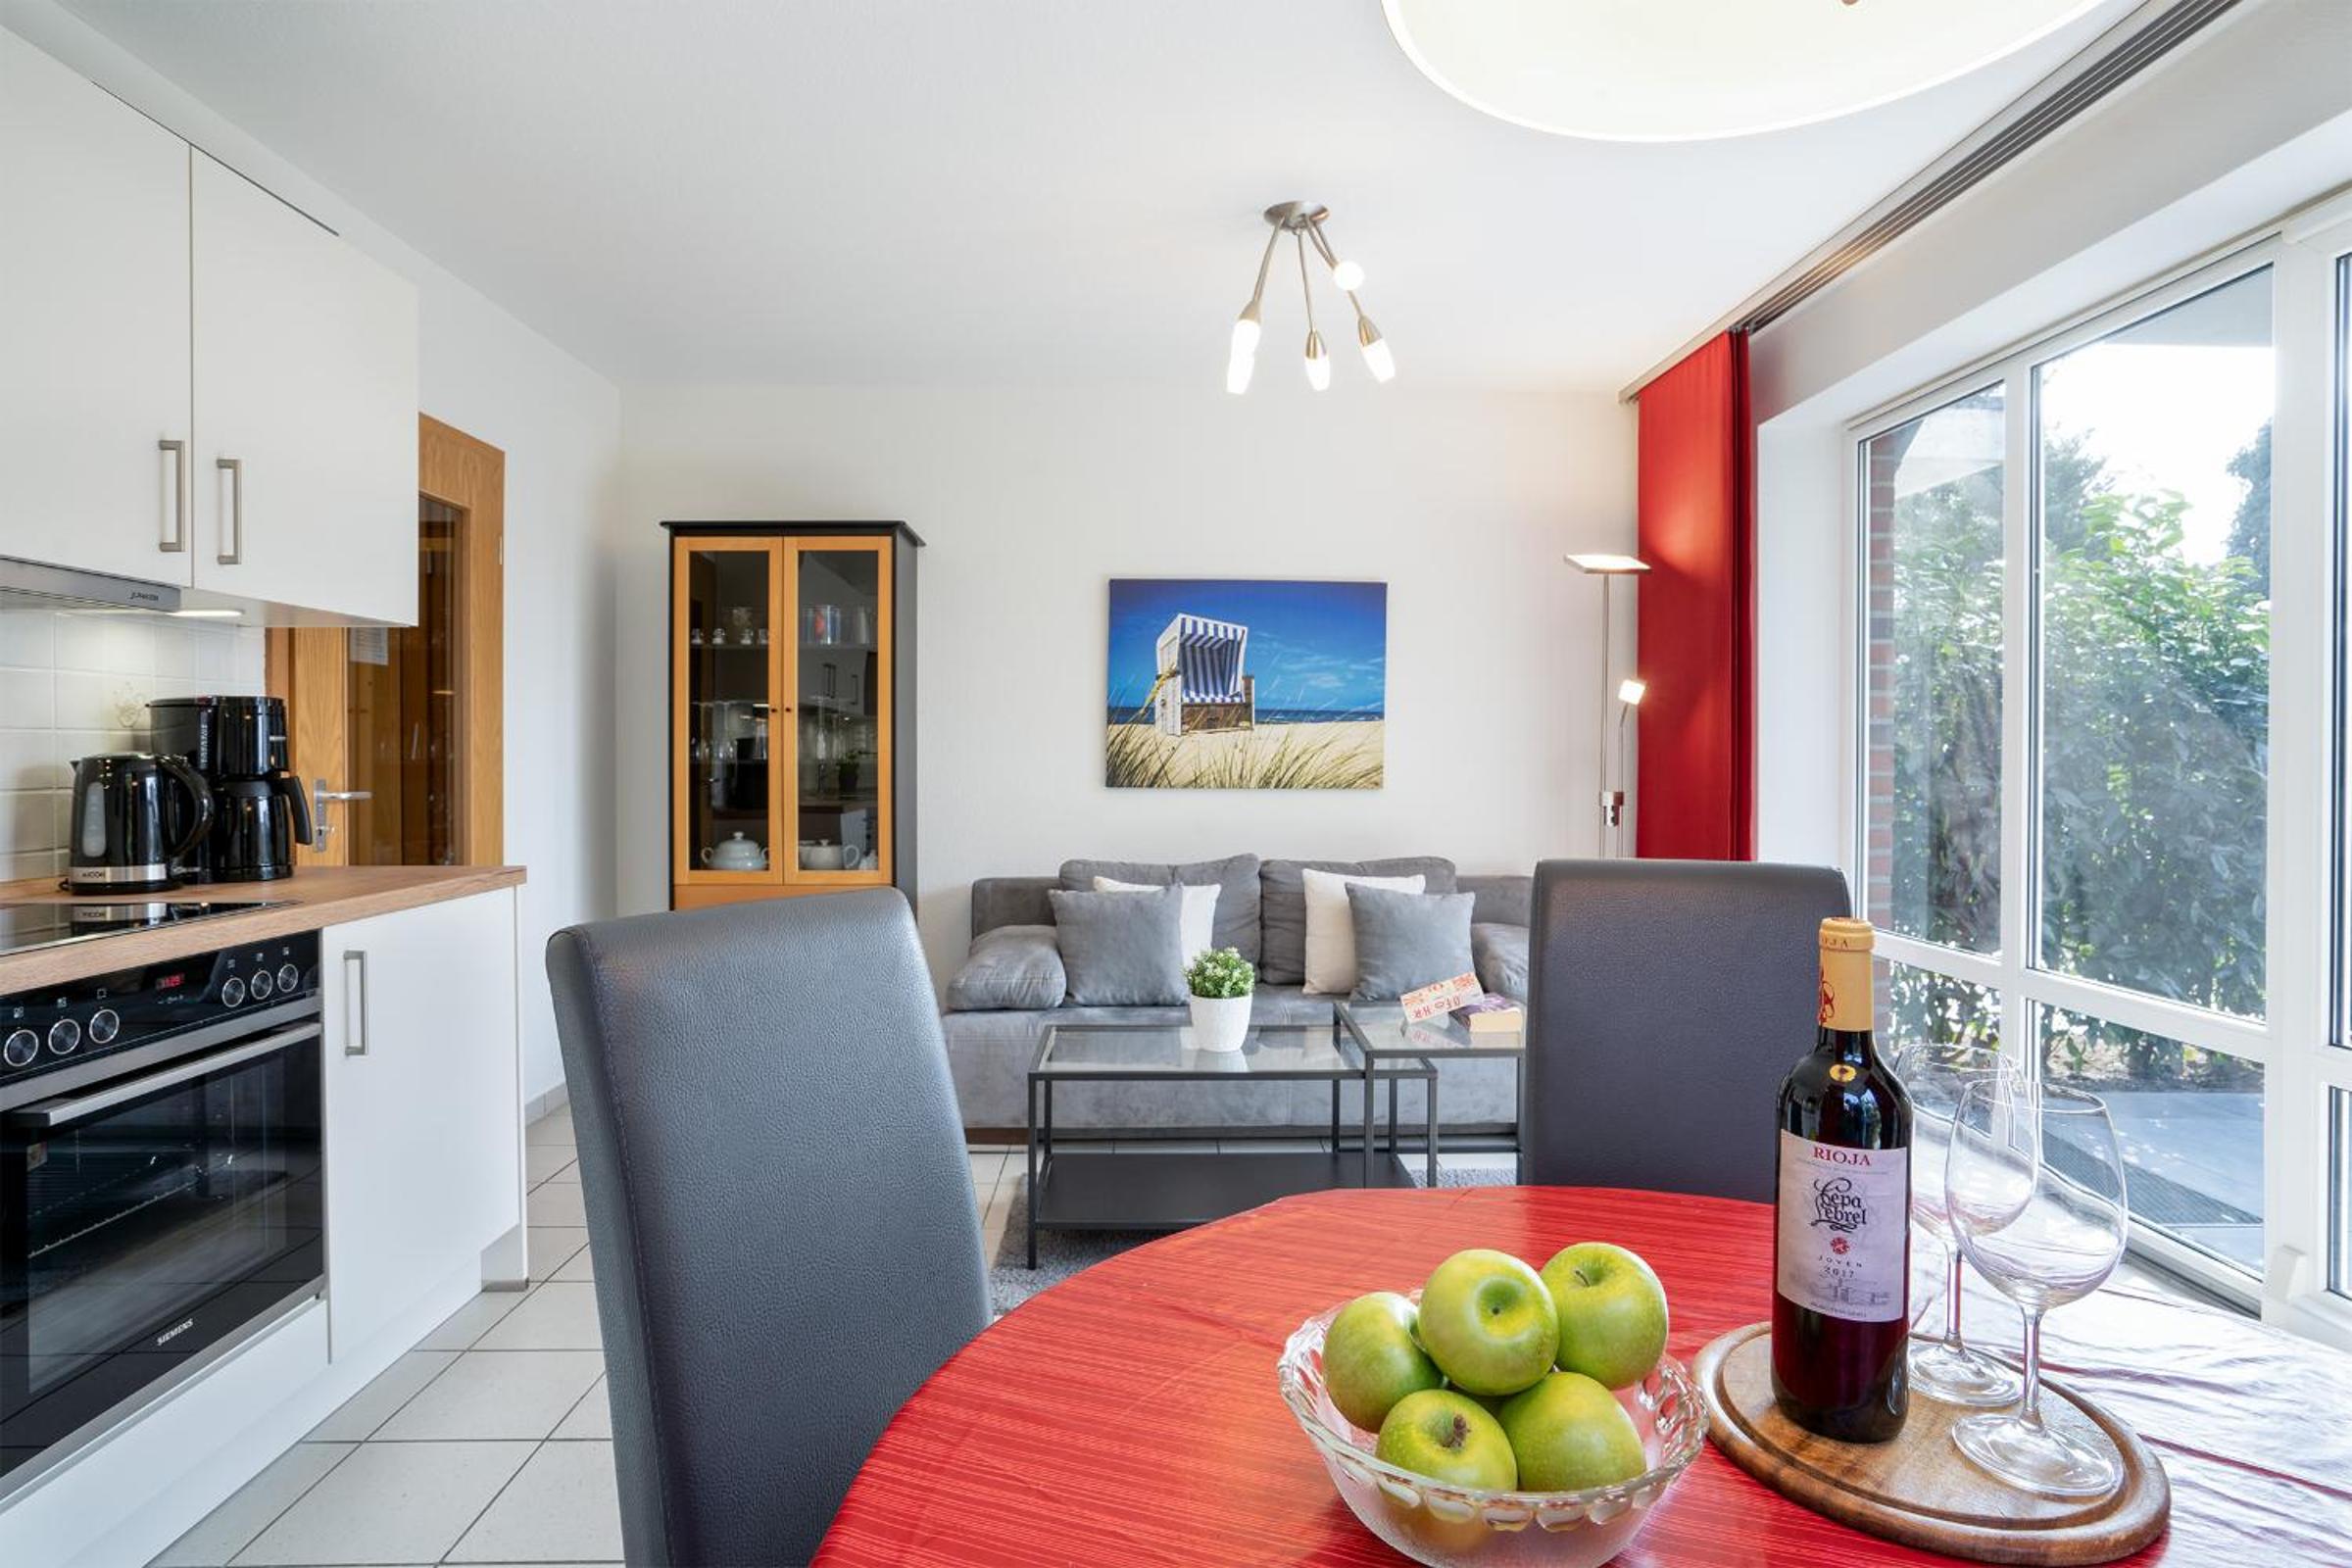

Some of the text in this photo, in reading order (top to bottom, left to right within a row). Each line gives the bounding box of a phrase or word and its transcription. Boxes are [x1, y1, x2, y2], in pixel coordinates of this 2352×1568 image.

[1813, 1147, 1871, 1166] RIOJA
[1813, 1177, 1863, 1208] Cepa
[1811, 1196, 1867, 1233] Lebrel
[1818, 1254, 1863, 1268] JOVEN
[157, 1318, 193, 1346] SIEMENS
